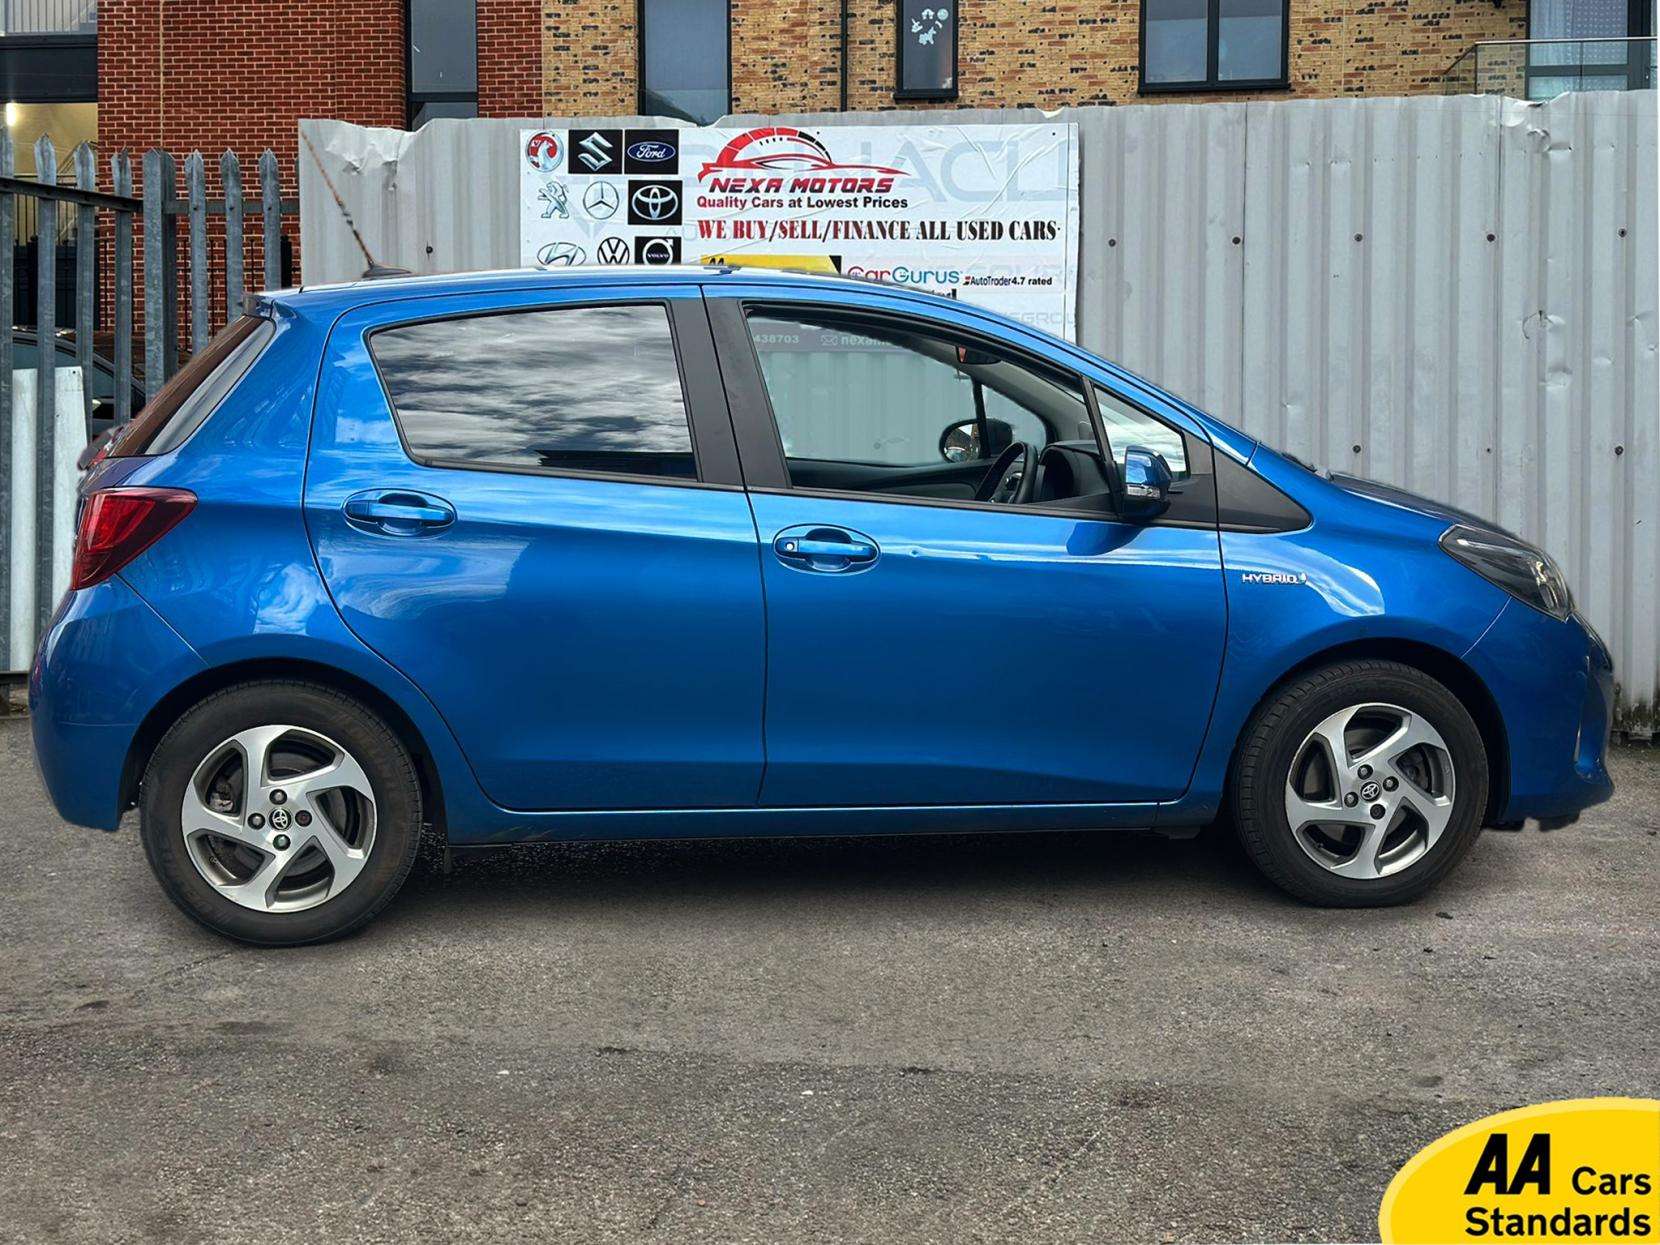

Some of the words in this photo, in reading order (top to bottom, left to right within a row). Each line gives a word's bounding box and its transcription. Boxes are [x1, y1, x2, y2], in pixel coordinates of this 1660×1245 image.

[636, 144, 666, 159] Ford
[709, 178, 784, 193] NEXA
[789, 178, 895, 193] MOTORS
[697, 196, 747, 210] Quality
[751, 196, 784, 208] Cars
[788, 196, 803, 208] at
[807, 196, 859, 208] Lowest
[863, 196, 908, 208] Prices
[697, 220, 727, 240] WE
[915, 220, 951, 240] ALL
[957, 220, 1004, 240] USED
[1009, 220, 1057, 240] CARS
[848, 266, 960, 284] CarGurus
[1028, 277, 1053, 286] rated
[1242, 573, 1299, 584] HYBRID
